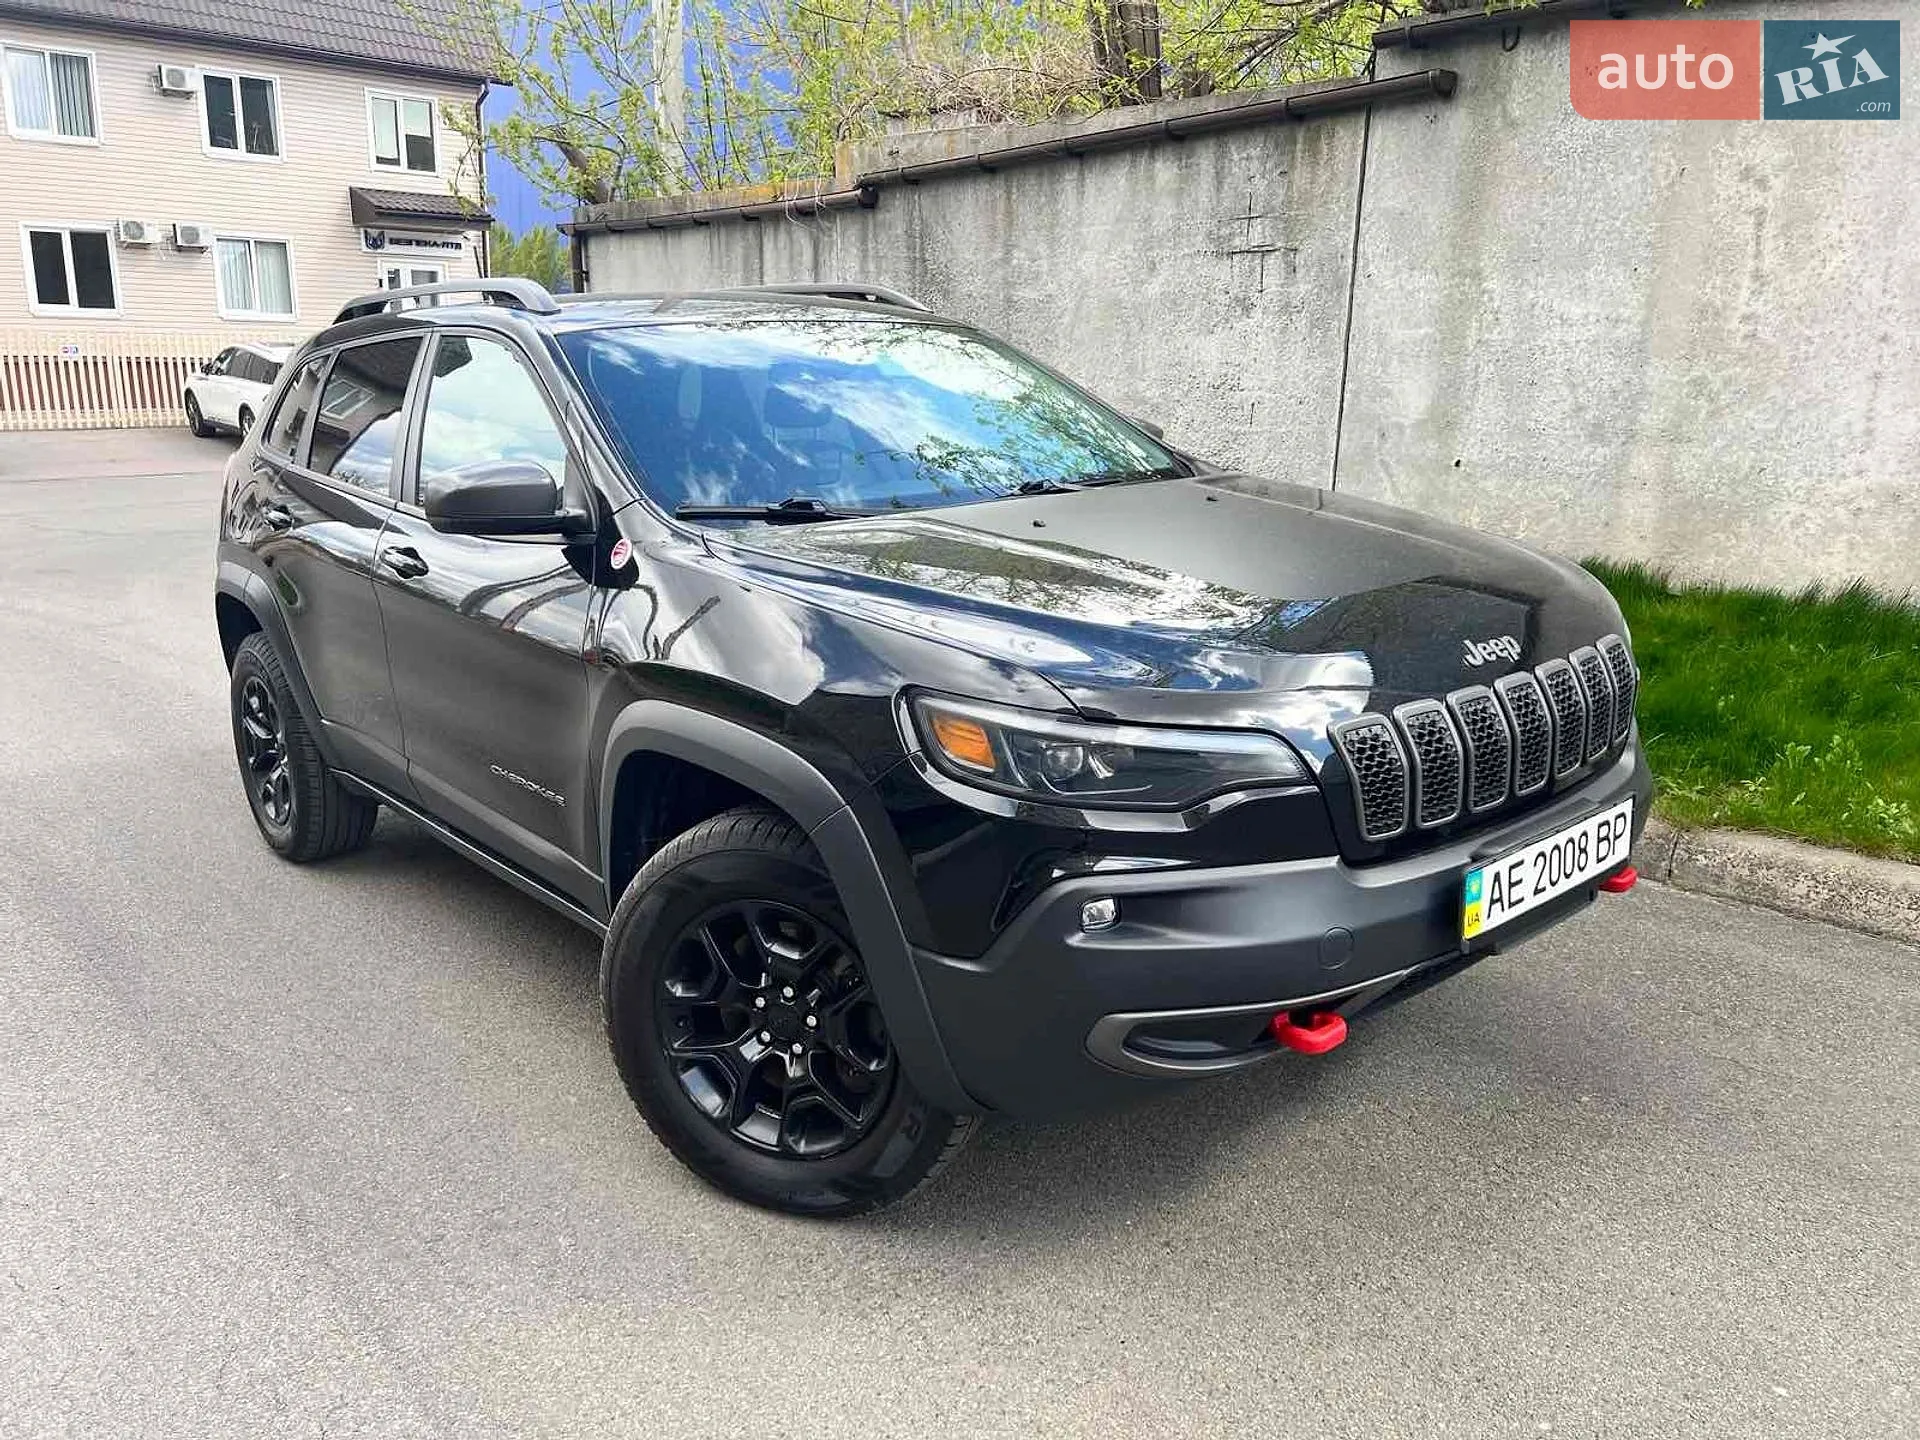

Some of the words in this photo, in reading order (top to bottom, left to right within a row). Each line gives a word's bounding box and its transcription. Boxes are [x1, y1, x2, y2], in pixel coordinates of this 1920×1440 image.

[1462, 635, 1522, 667] Jeep
[1487, 860, 1524, 919] AE
[1533, 831, 1589, 896] 2008
[1596, 812, 1627, 864] BP
[1467, 912, 1481, 927] UA
